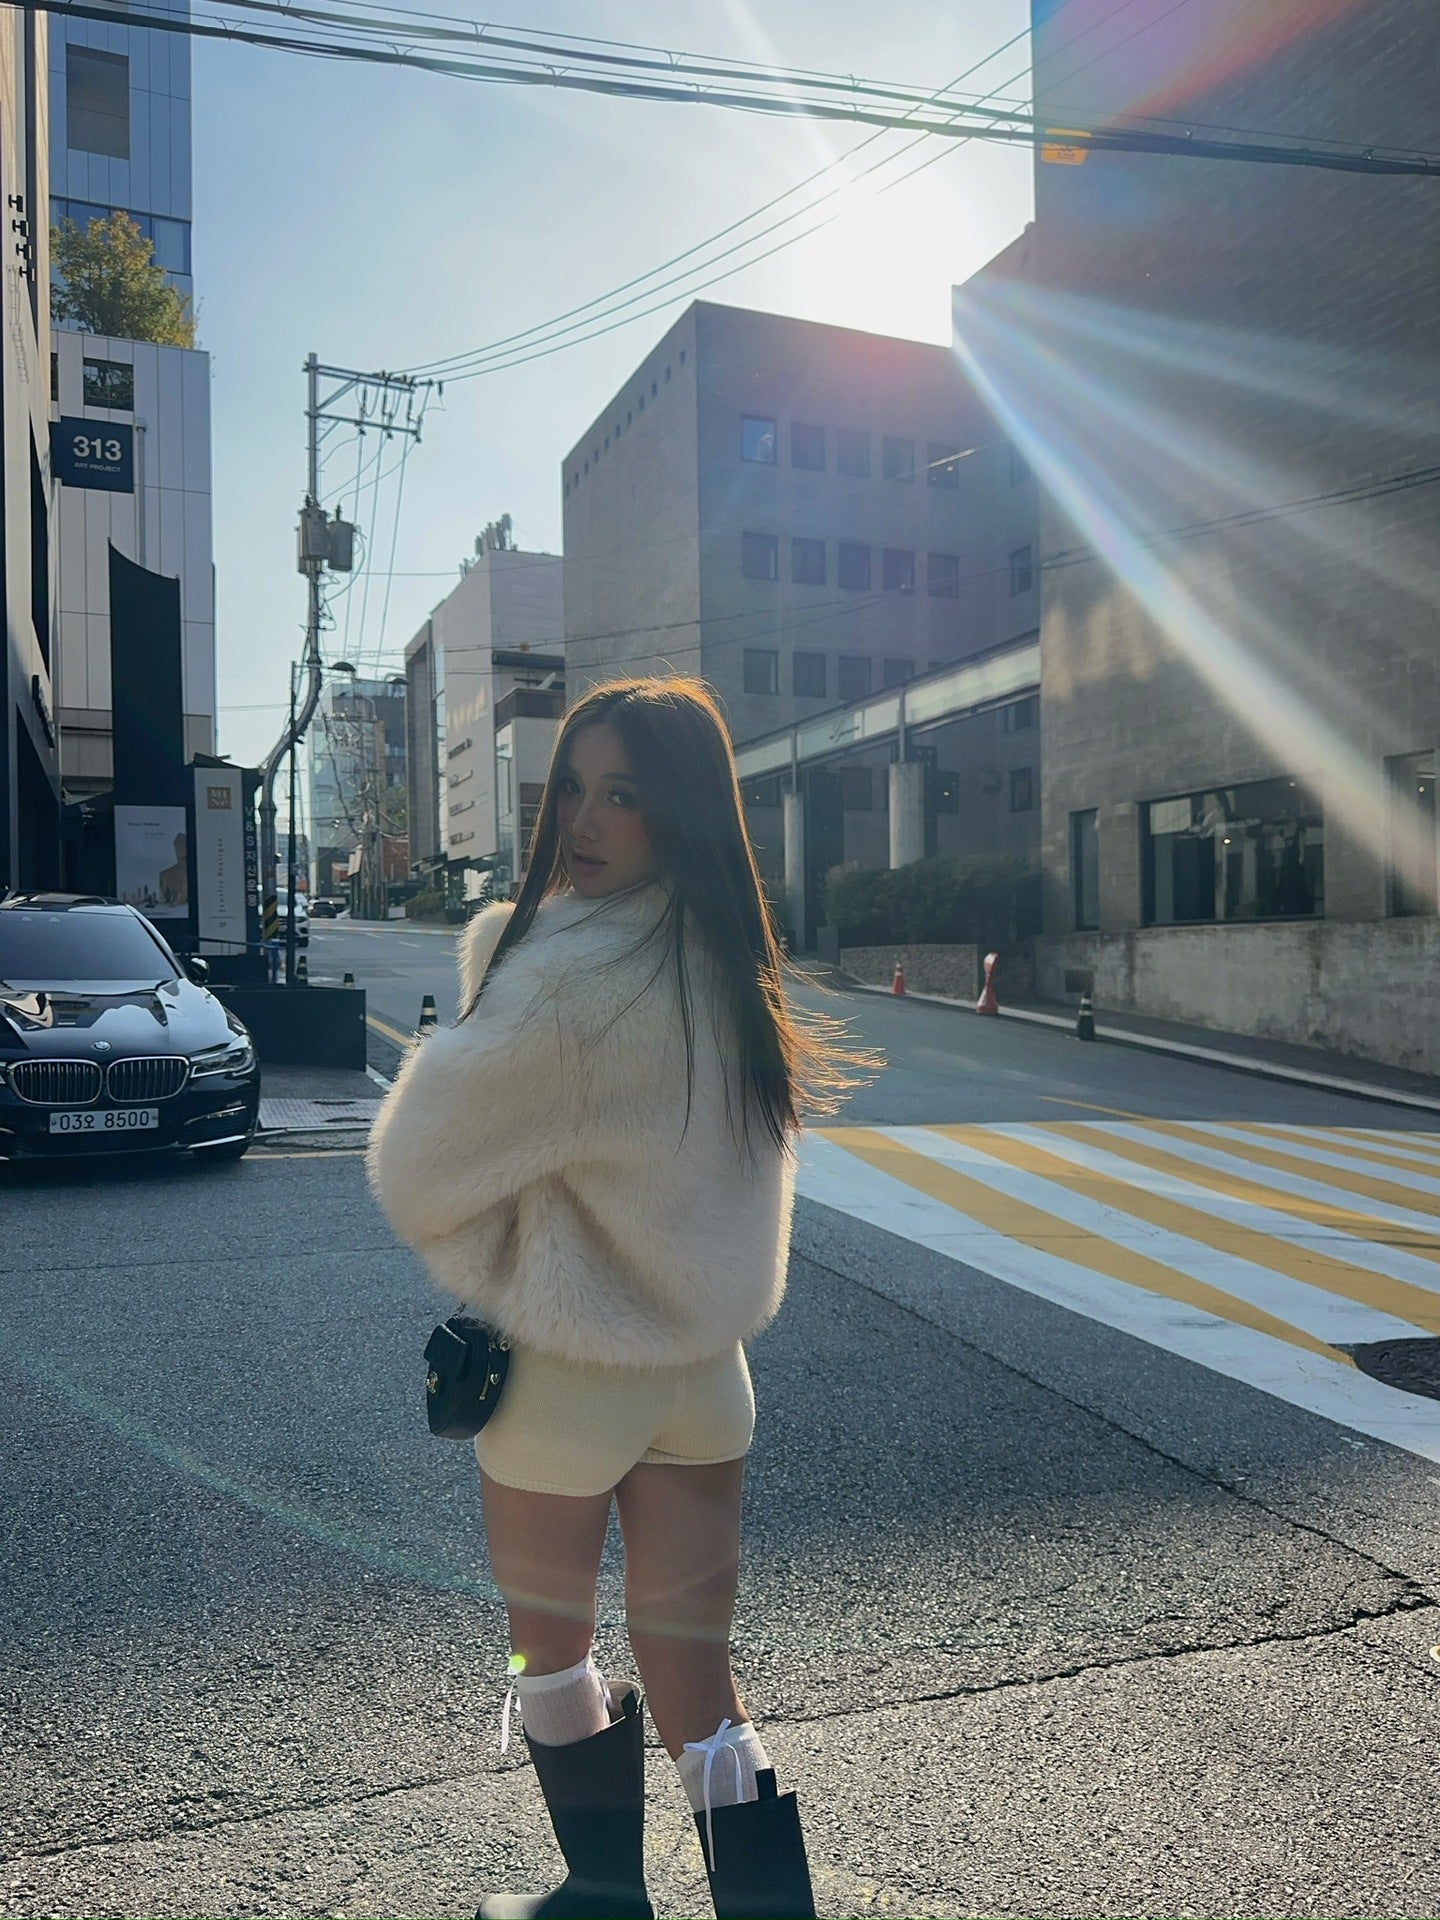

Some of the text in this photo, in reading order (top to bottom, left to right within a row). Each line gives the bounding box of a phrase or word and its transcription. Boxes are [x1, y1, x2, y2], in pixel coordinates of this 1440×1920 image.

[72, 435, 122, 461] 313
[89, 464, 121, 473] PROJECT
[59, 1110, 150, 1131] 03오 8500
